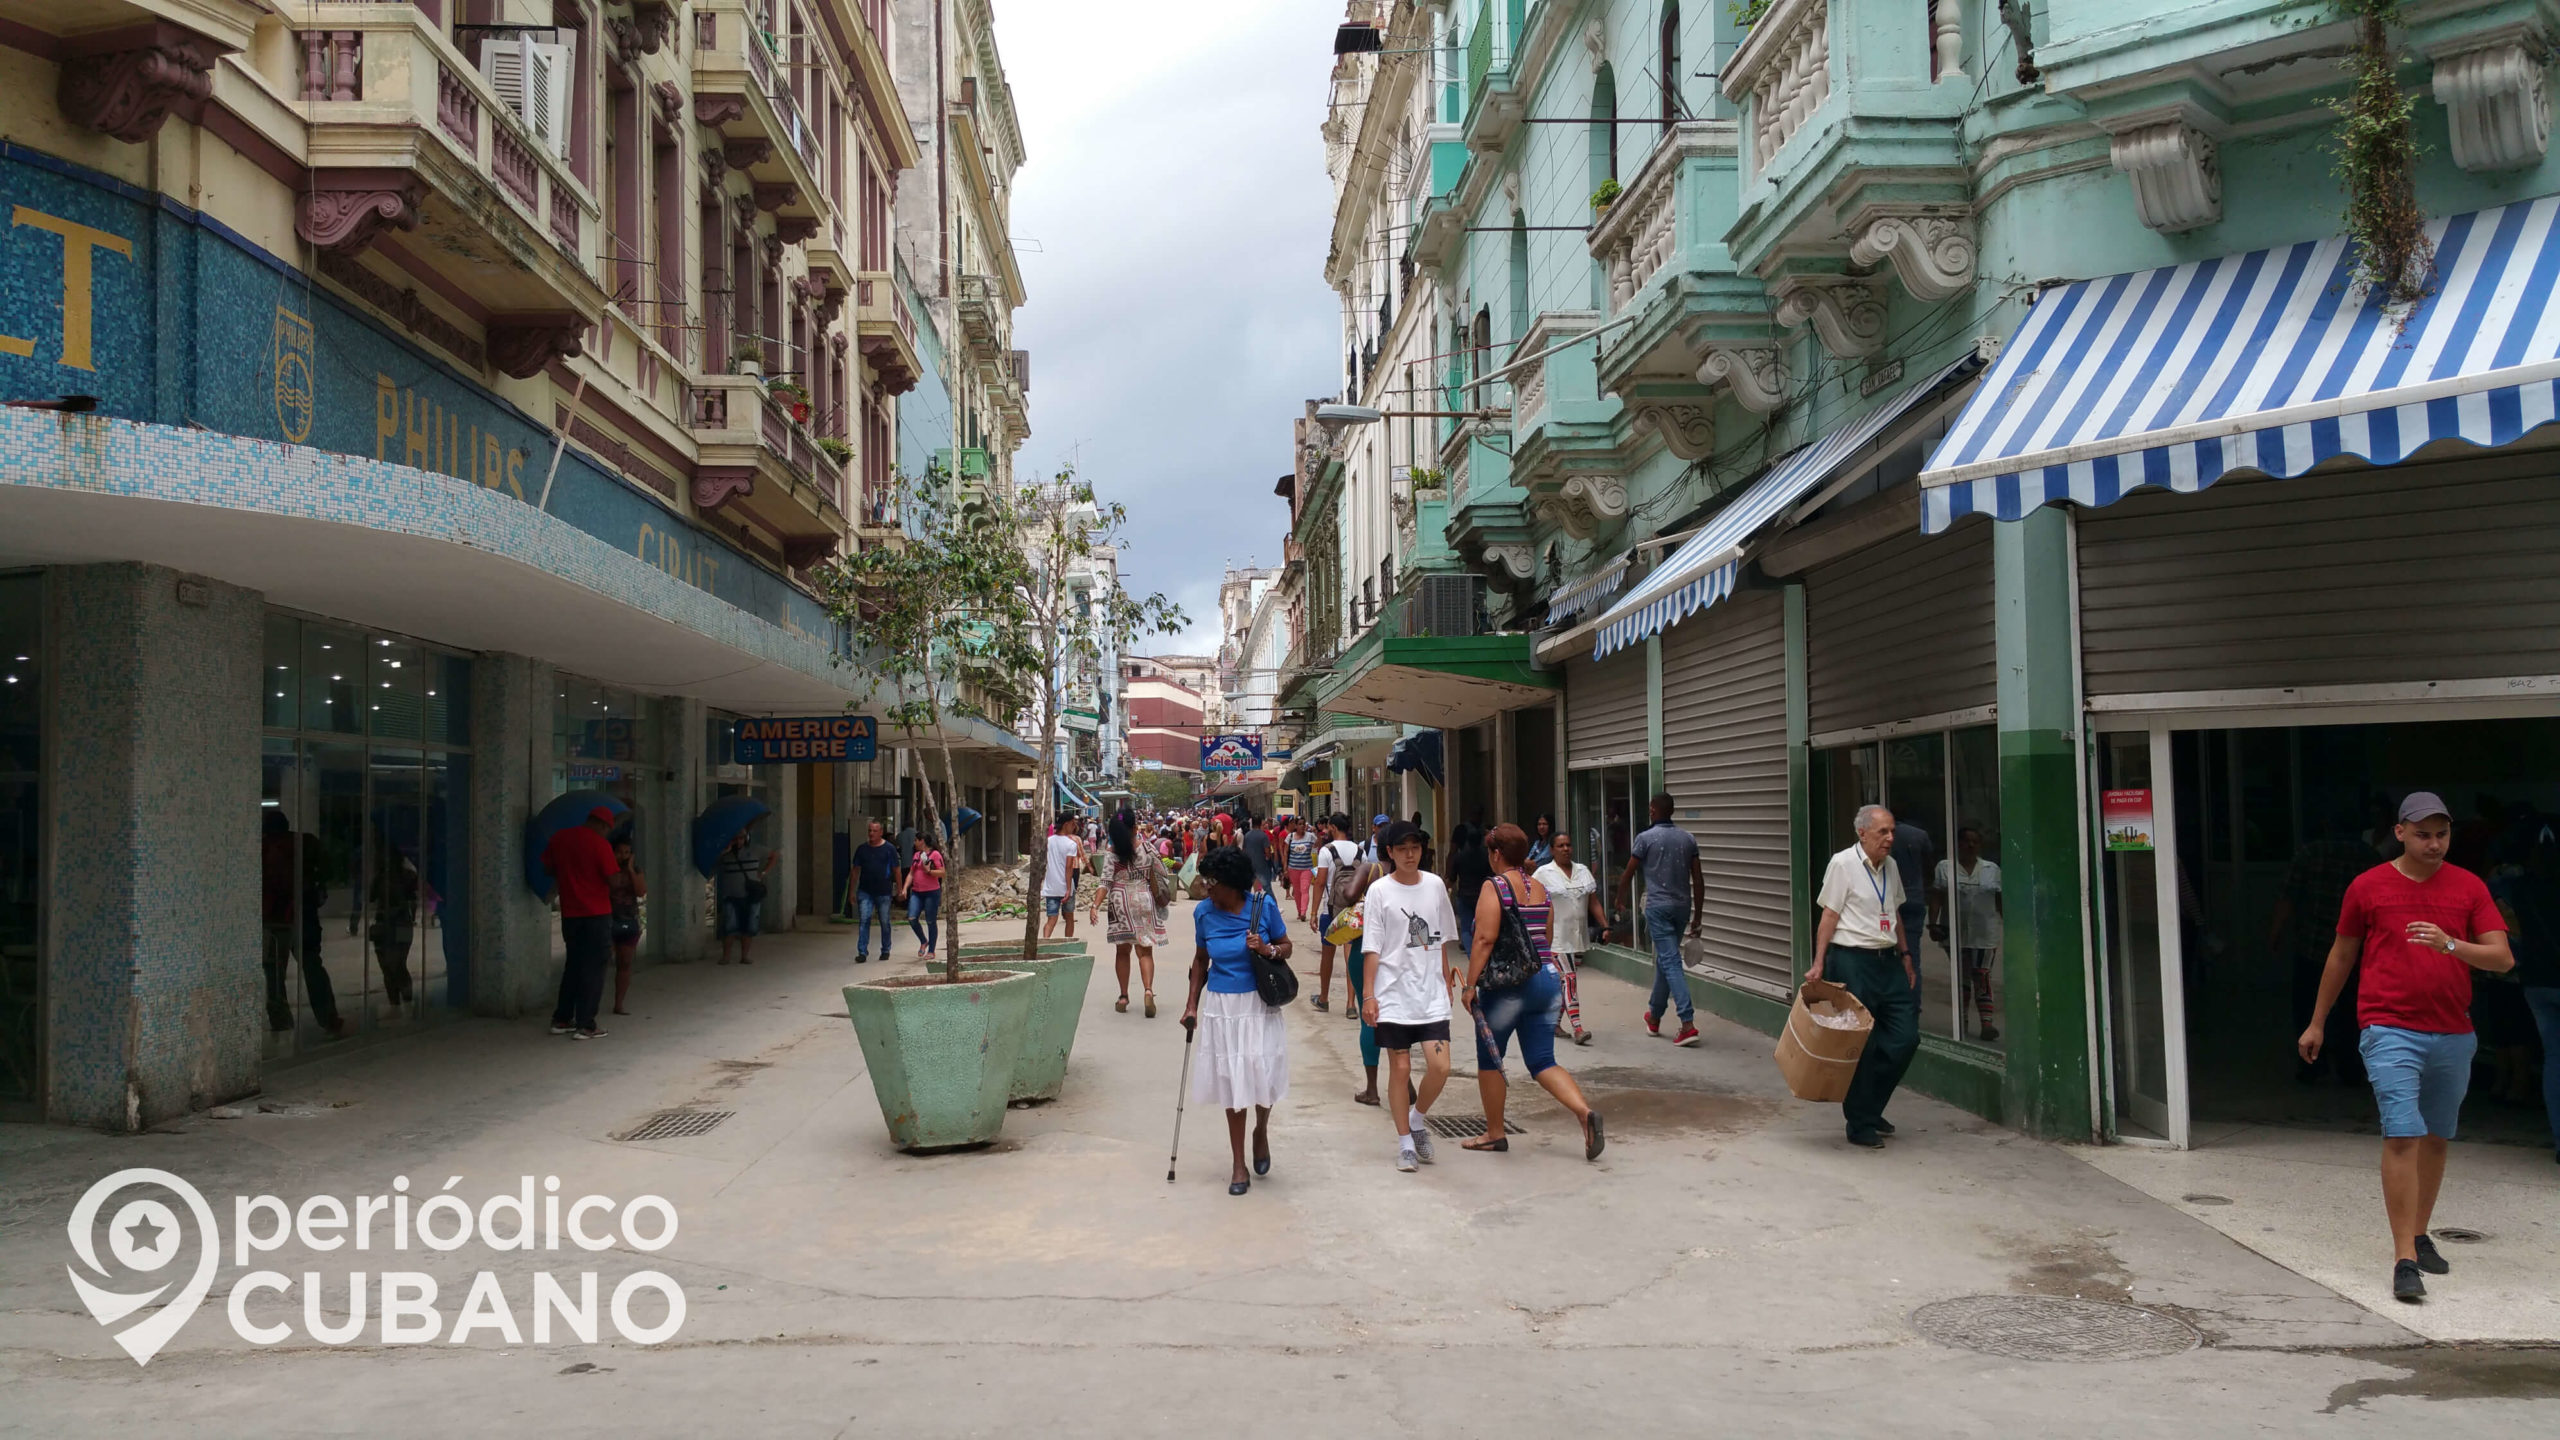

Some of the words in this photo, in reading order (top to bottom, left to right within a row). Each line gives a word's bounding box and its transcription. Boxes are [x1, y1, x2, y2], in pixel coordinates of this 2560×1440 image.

[279, 318, 312, 357] PHILIPS
[740, 719, 869, 740] AMERICA
[763, 739, 847, 759] LIBRE
[1205, 755, 1258, 769] Arlequin
